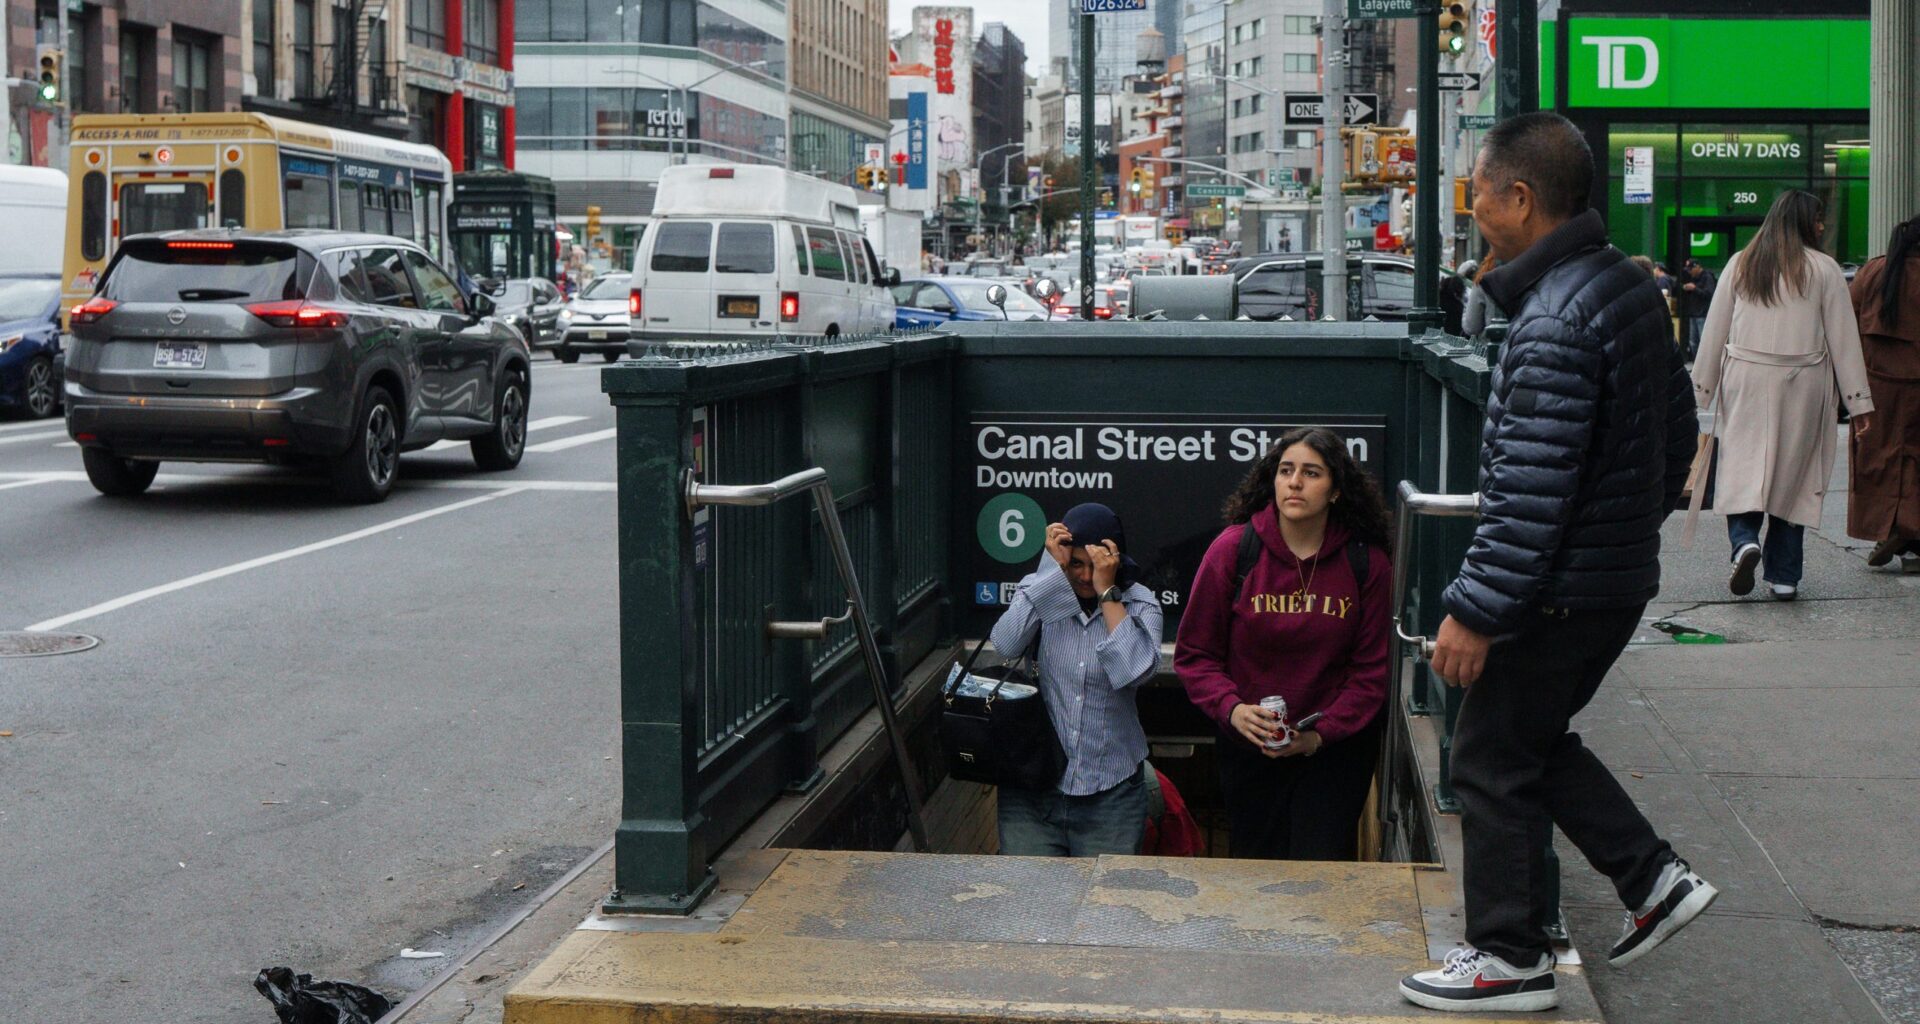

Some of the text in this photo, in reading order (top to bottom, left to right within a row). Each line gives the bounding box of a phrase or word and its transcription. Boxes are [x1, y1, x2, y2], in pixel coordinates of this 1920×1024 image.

[1358, 0, 1412, 13] Lafayette
[1581, 36, 1660, 88] TD
[1294, 104, 1360, 116] ONE AY
[1691, 142, 1801, 158] OPEN 7 DAYS
[1733, 192, 1758, 204] 250
[977, 426, 1083, 460] Canal
[1096, 427, 1216, 461] Street
[976, 465, 1113, 489] Downtown
[998, 509, 1026, 548] 6
[1160, 590, 1179, 605] St
